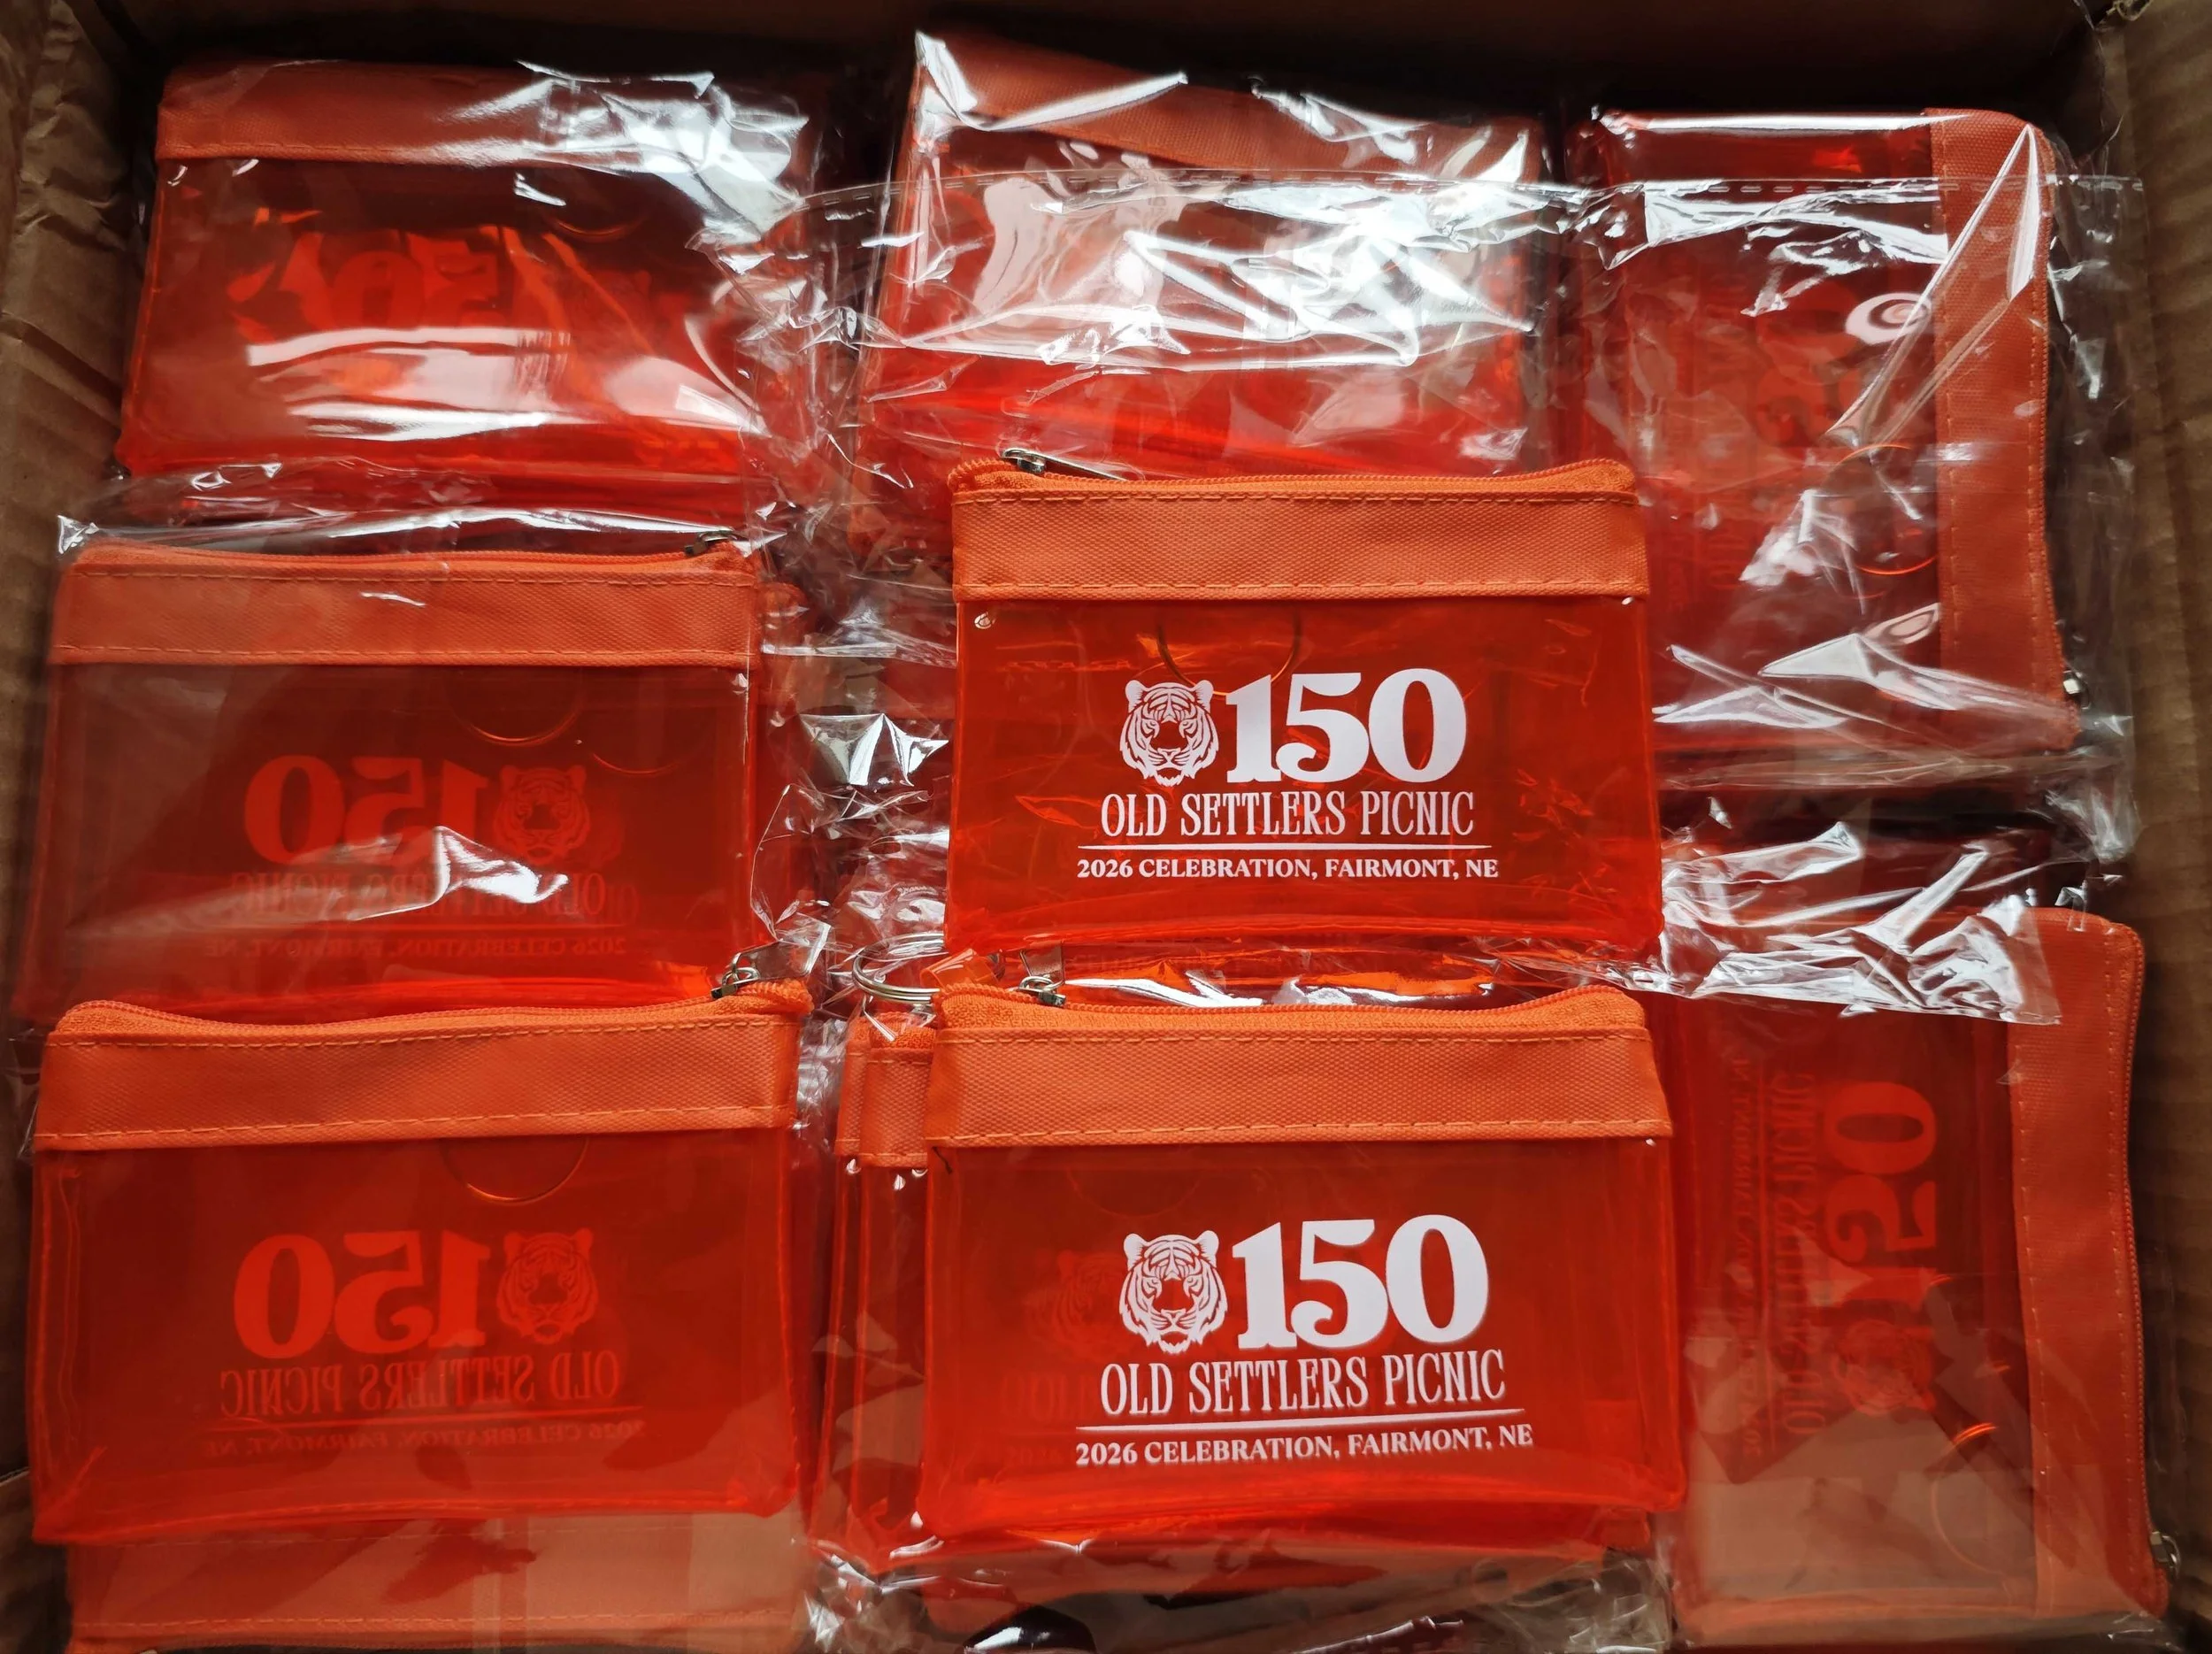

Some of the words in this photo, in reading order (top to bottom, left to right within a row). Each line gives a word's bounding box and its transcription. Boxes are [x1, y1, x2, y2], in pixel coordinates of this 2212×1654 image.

[1225, 668, 1468, 784] 150
[1101, 793, 1168, 837] OLD
[1180, 791, 1346, 837] SETTLERS
[1361, 790, 1474, 836] PICNIC
[1077, 858, 1133, 879] 2026
[1139, 858, 1318, 881] CELEBRATION,
[1325, 858, 1459, 881] FAIRMONT,
[1465, 858, 1499, 879] NE
[1232, 1213, 1489, 1350] 150
[1100, 1362, 1173, 1416] OLD
[1188, 1356, 1370, 1413] SETTLERS
[1383, 1349, 1506, 1407] PICNIC
[1075, 1442, 1139, 1466] 2026
[1144, 1435, 1340, 1465] CELEBRATION,
[1348, 1427, 1492, 1457] FAIRMONT,
[1499, 1423, 1534, 1448] NE
